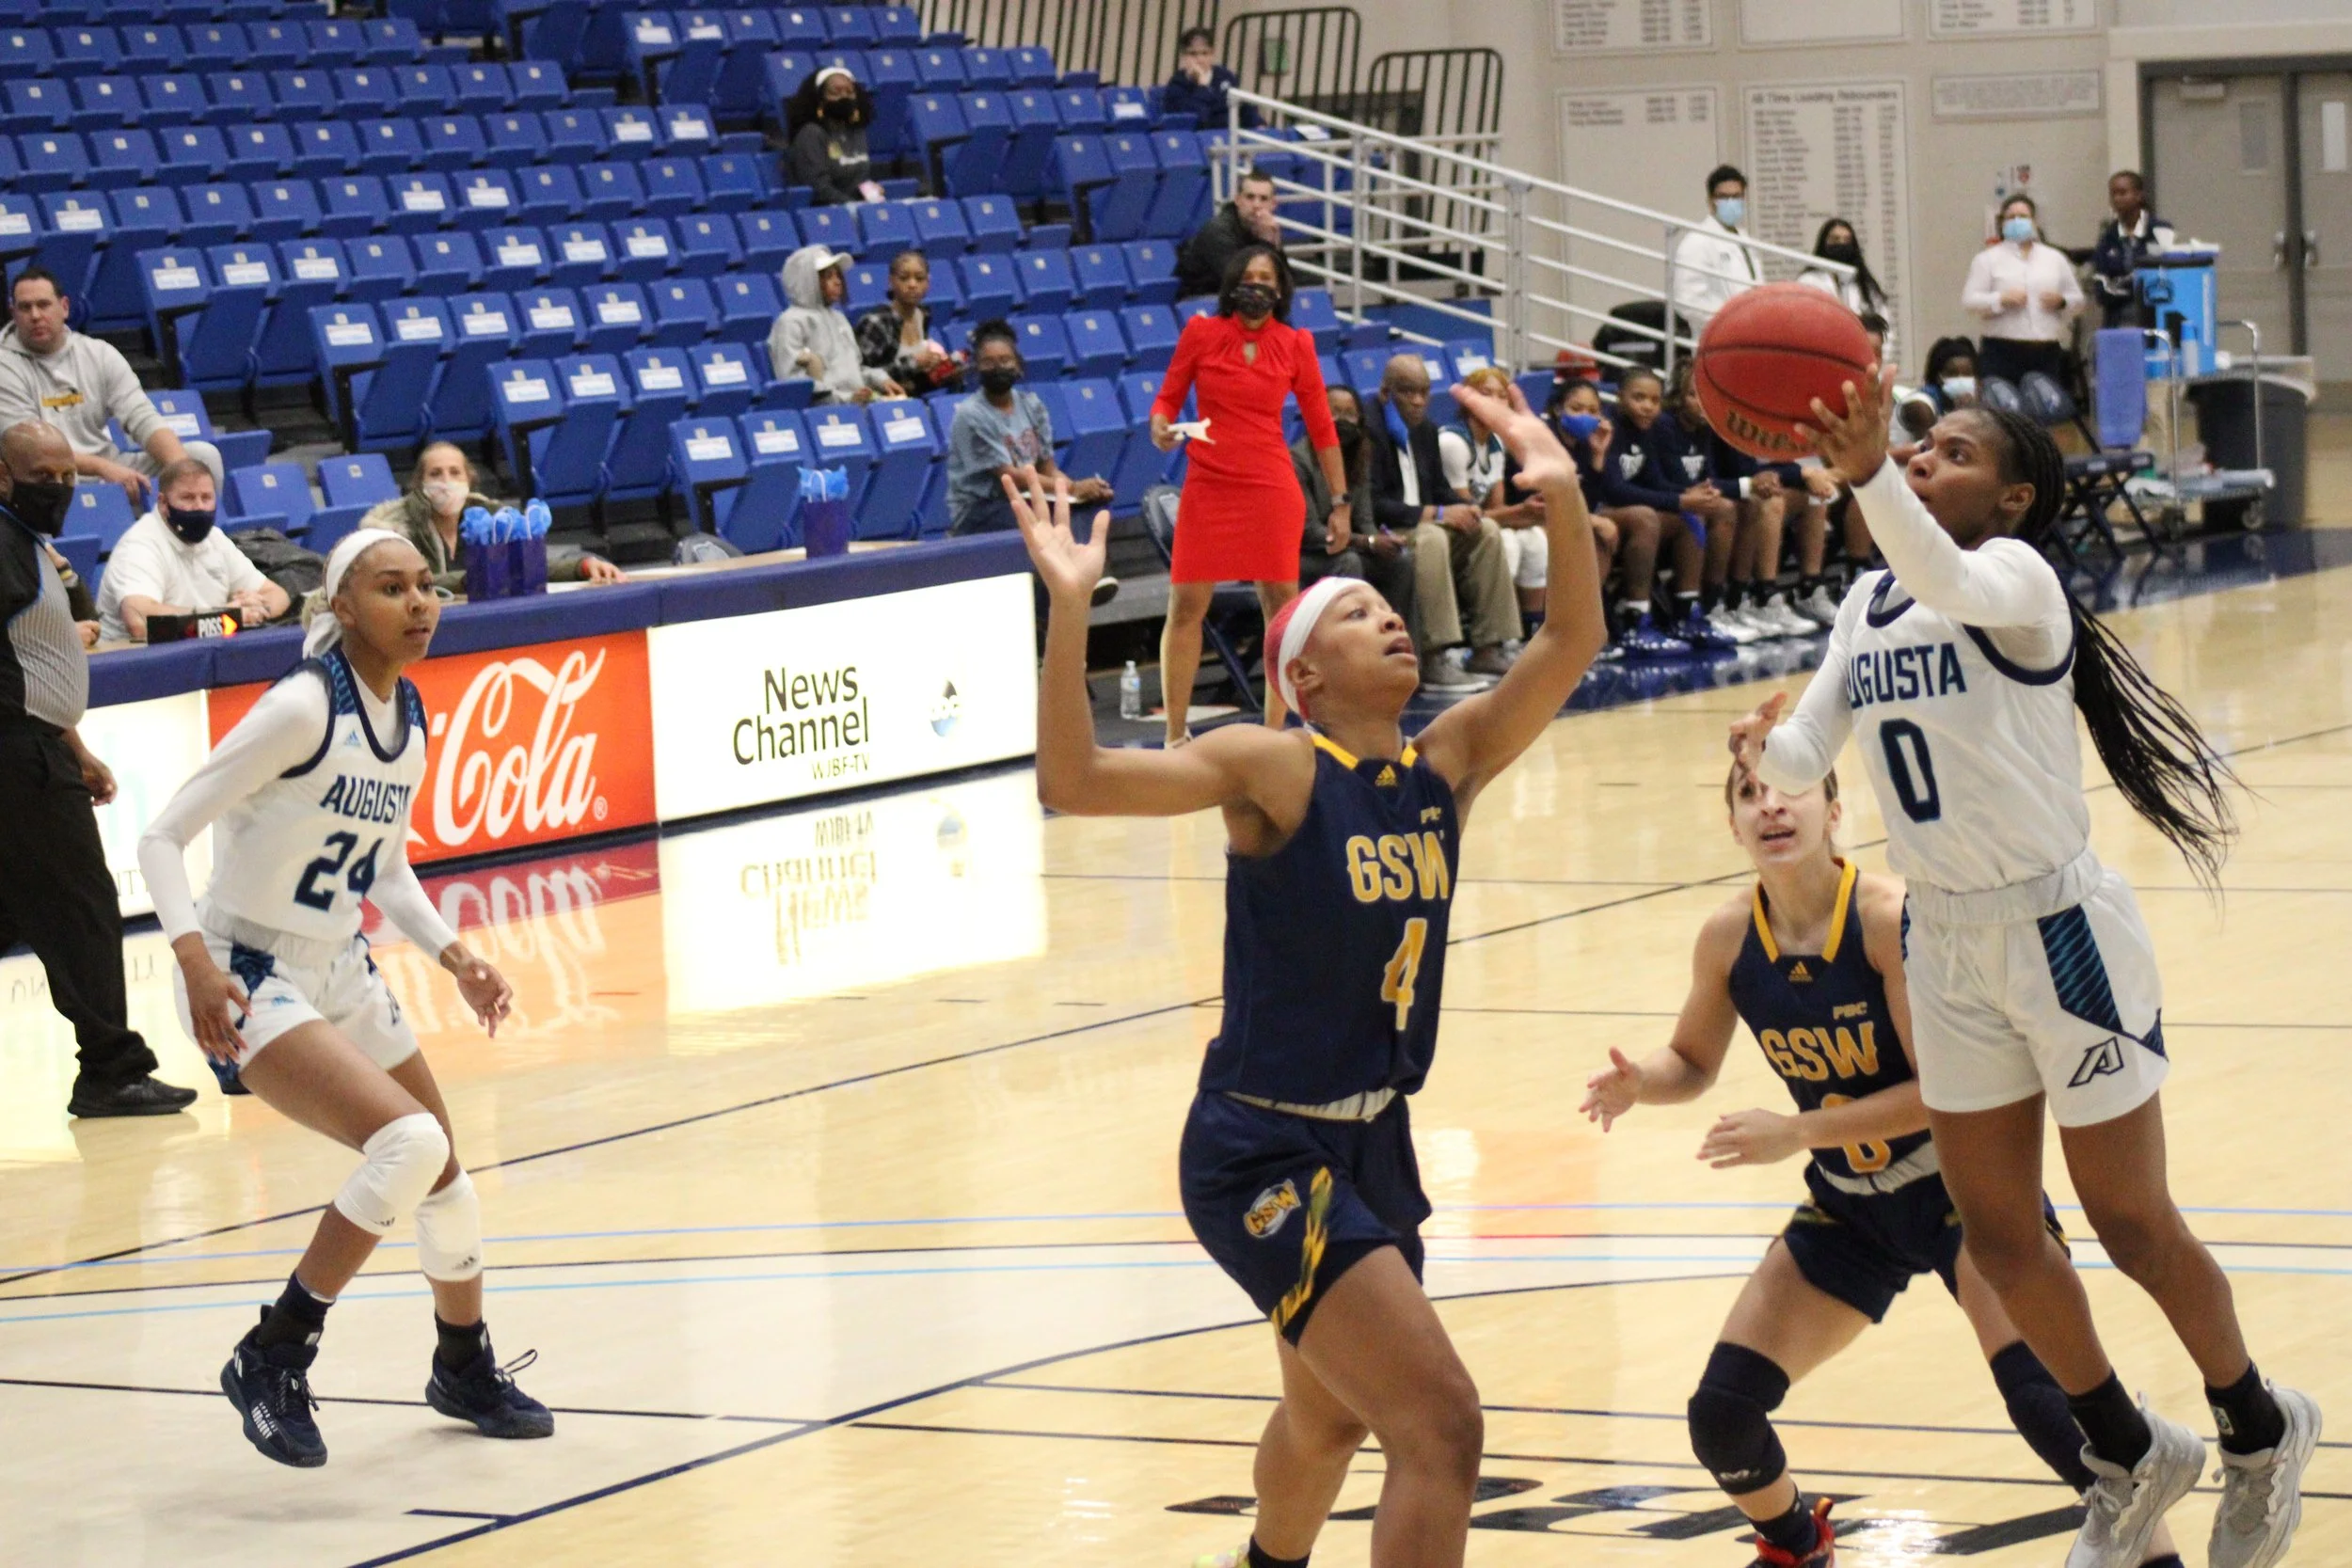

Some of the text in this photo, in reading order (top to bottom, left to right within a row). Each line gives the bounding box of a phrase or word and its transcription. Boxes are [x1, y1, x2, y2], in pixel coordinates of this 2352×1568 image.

[198, 616, 223, 639] POSS
[764, 666, 859, 715] News
[1848, 642, 1967, 709] UGUSTA
[733, 696, 869, 765] Channel
[1879, 718, 1942, 823] 0
[294, 830, 384, 912] 24
[1346, 832, 1450, 903] GSW
[1381, 917, 1428, 1031] 4
[1760, 1021, 1879, 1082] GSW
